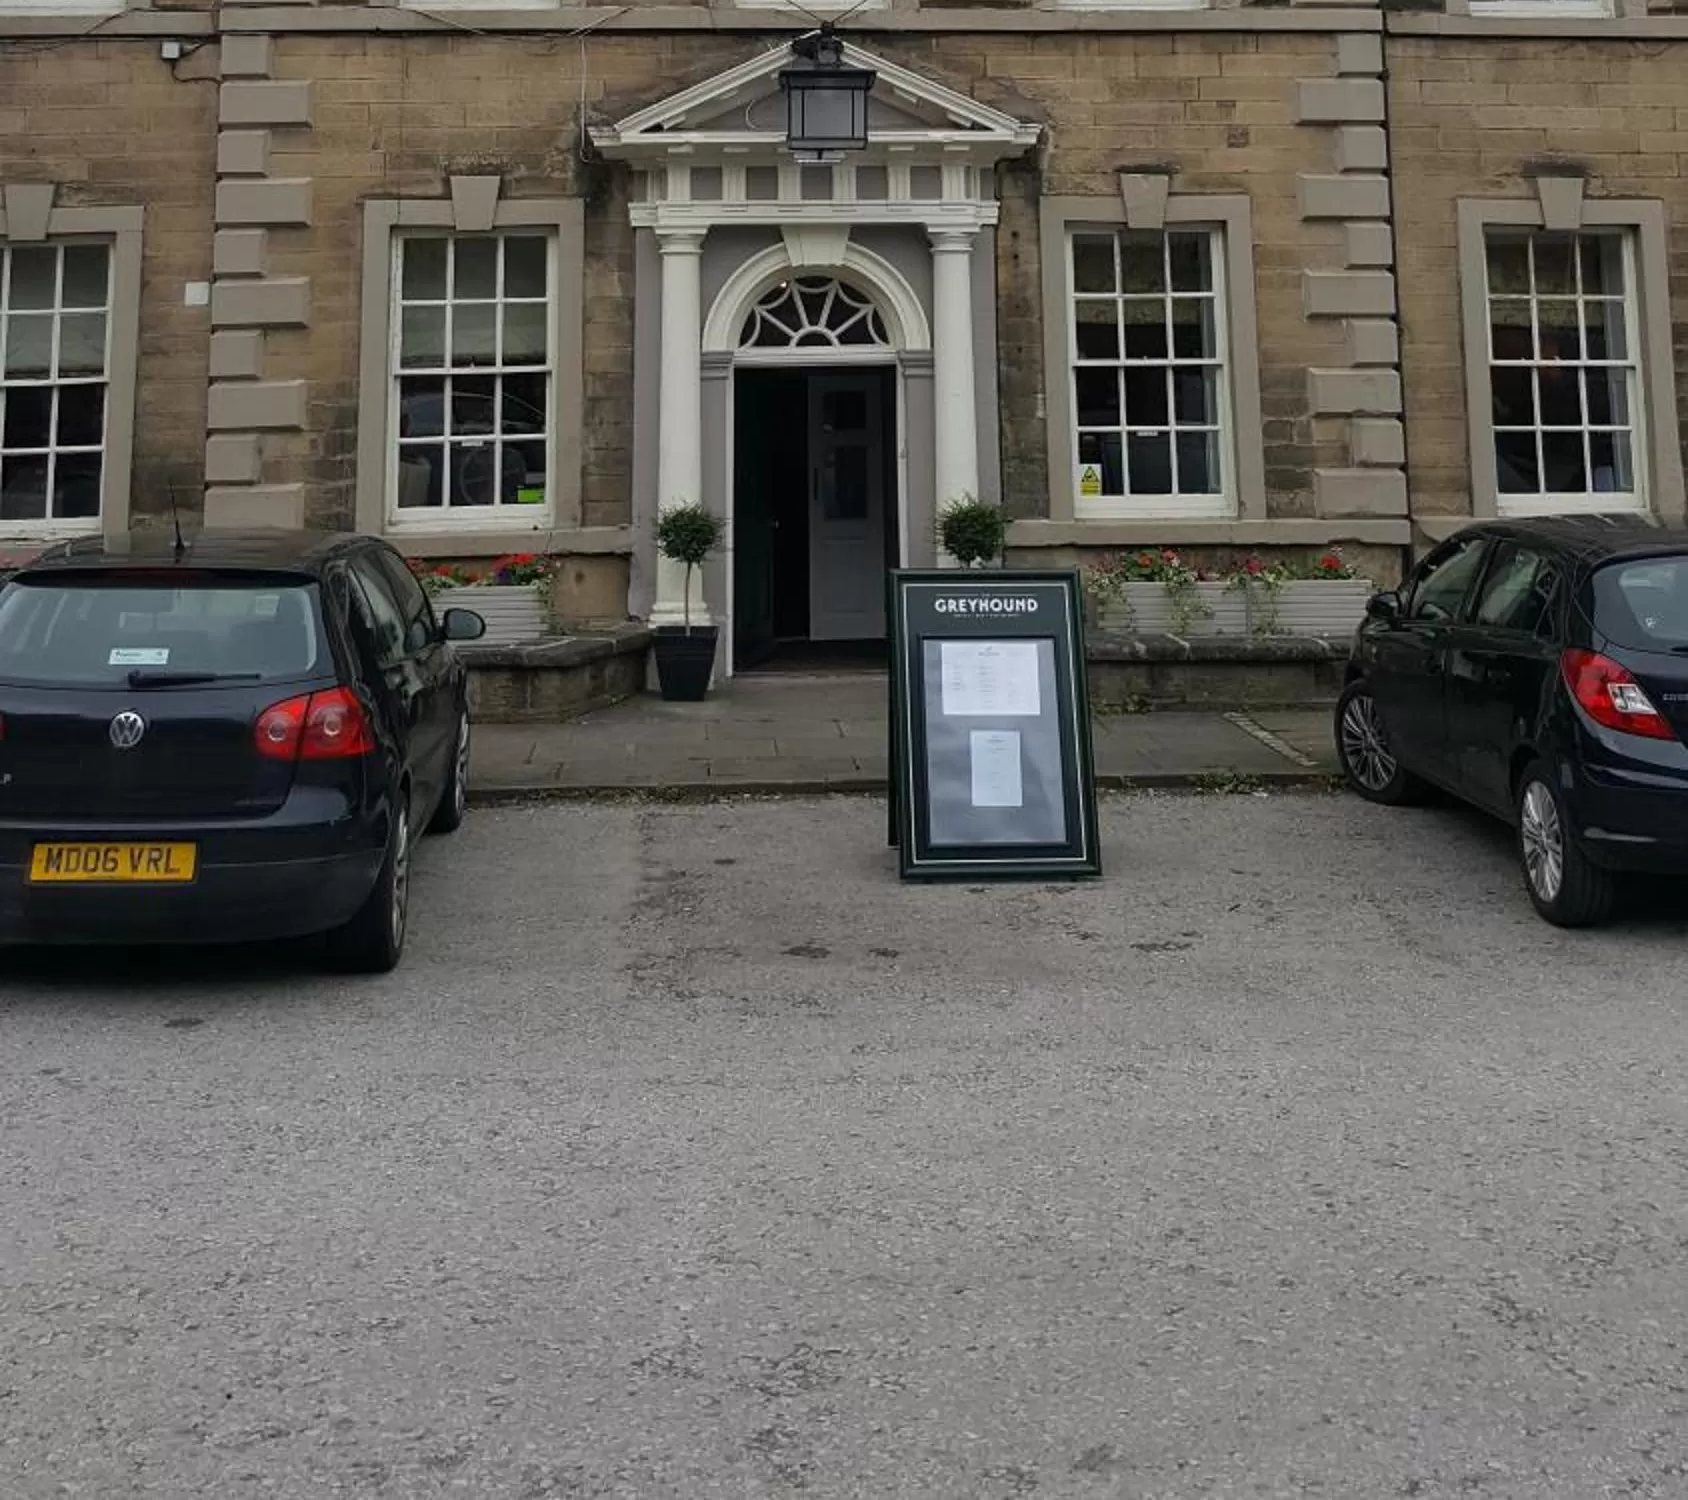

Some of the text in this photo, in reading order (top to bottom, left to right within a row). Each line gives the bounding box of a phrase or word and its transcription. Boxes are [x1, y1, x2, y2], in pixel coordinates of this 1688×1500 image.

[934, 598, 1038, 613] GREYHOUND
[44, 847, 180, 874] MD06 VRL
